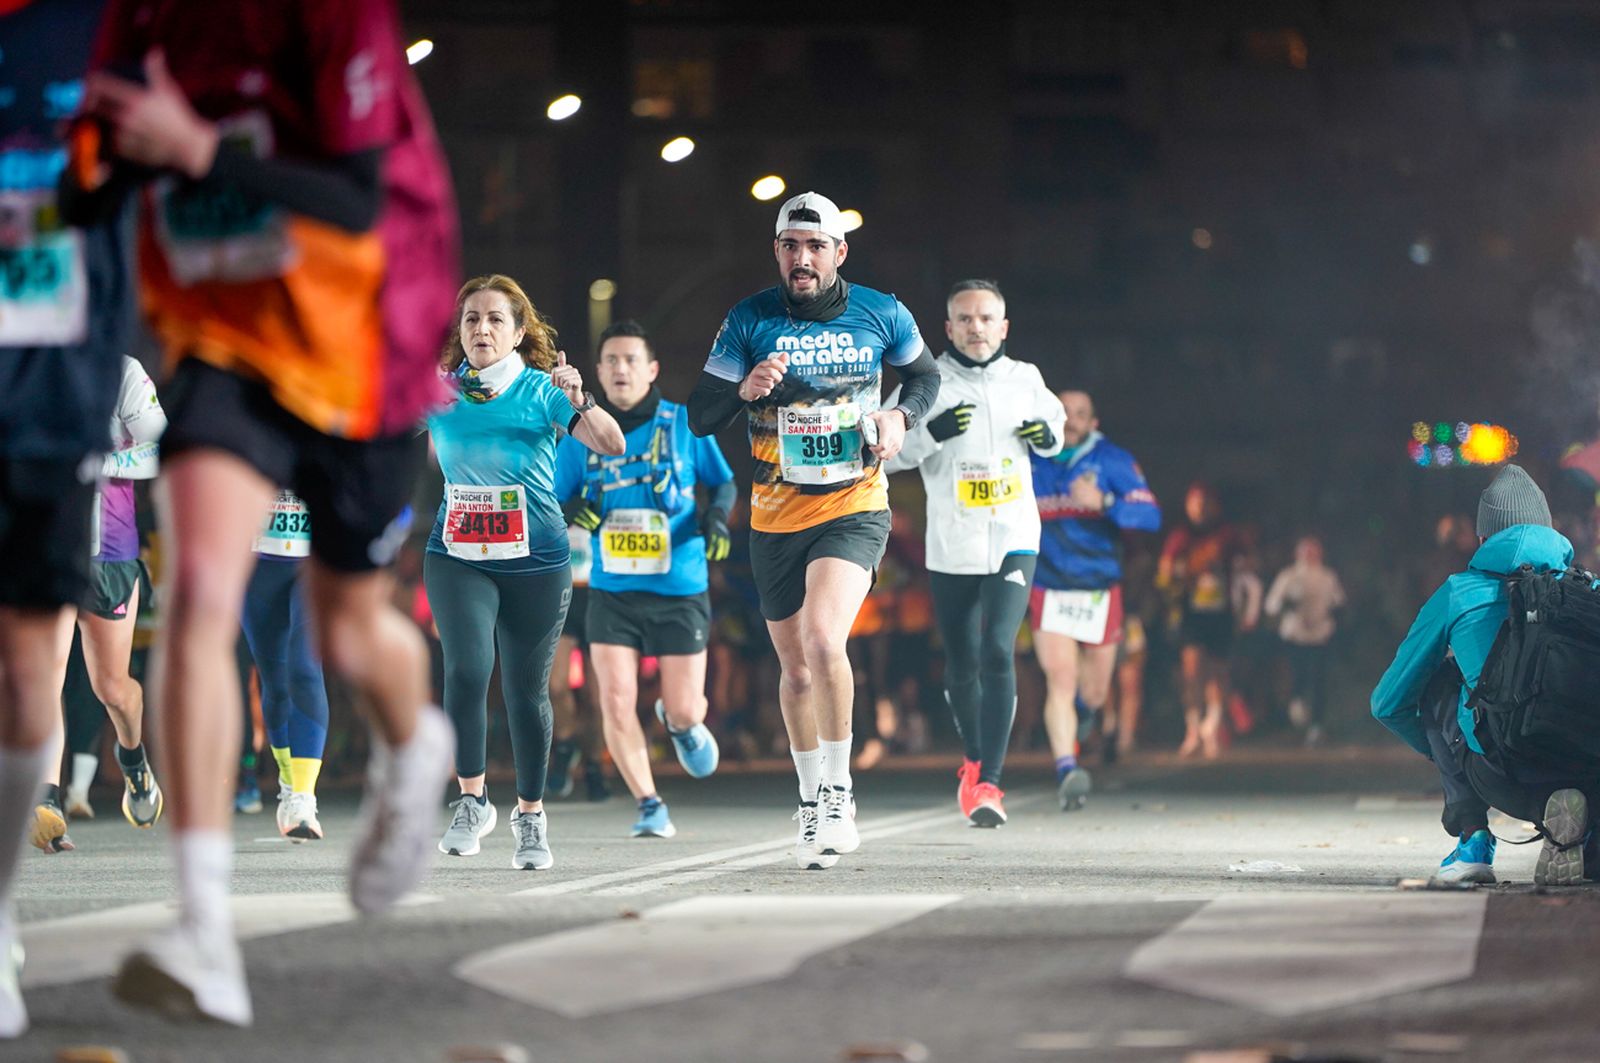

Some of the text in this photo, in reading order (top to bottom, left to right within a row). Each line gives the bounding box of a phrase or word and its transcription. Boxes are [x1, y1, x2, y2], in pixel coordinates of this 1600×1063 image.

[776, 331, 853, 350] media
[797, 366, 829, 376] CIUDAD
[833, 365, 843, 373] DE
[797, 416, 822, 424] NOCHE
[788, 425, 805, 434] SAN
[802, 433, 843, 458] 399
[483, 495, 493, 503] DE
[268, 512, 311, 533] 7332
[609, 533, 661, 552] 12633
